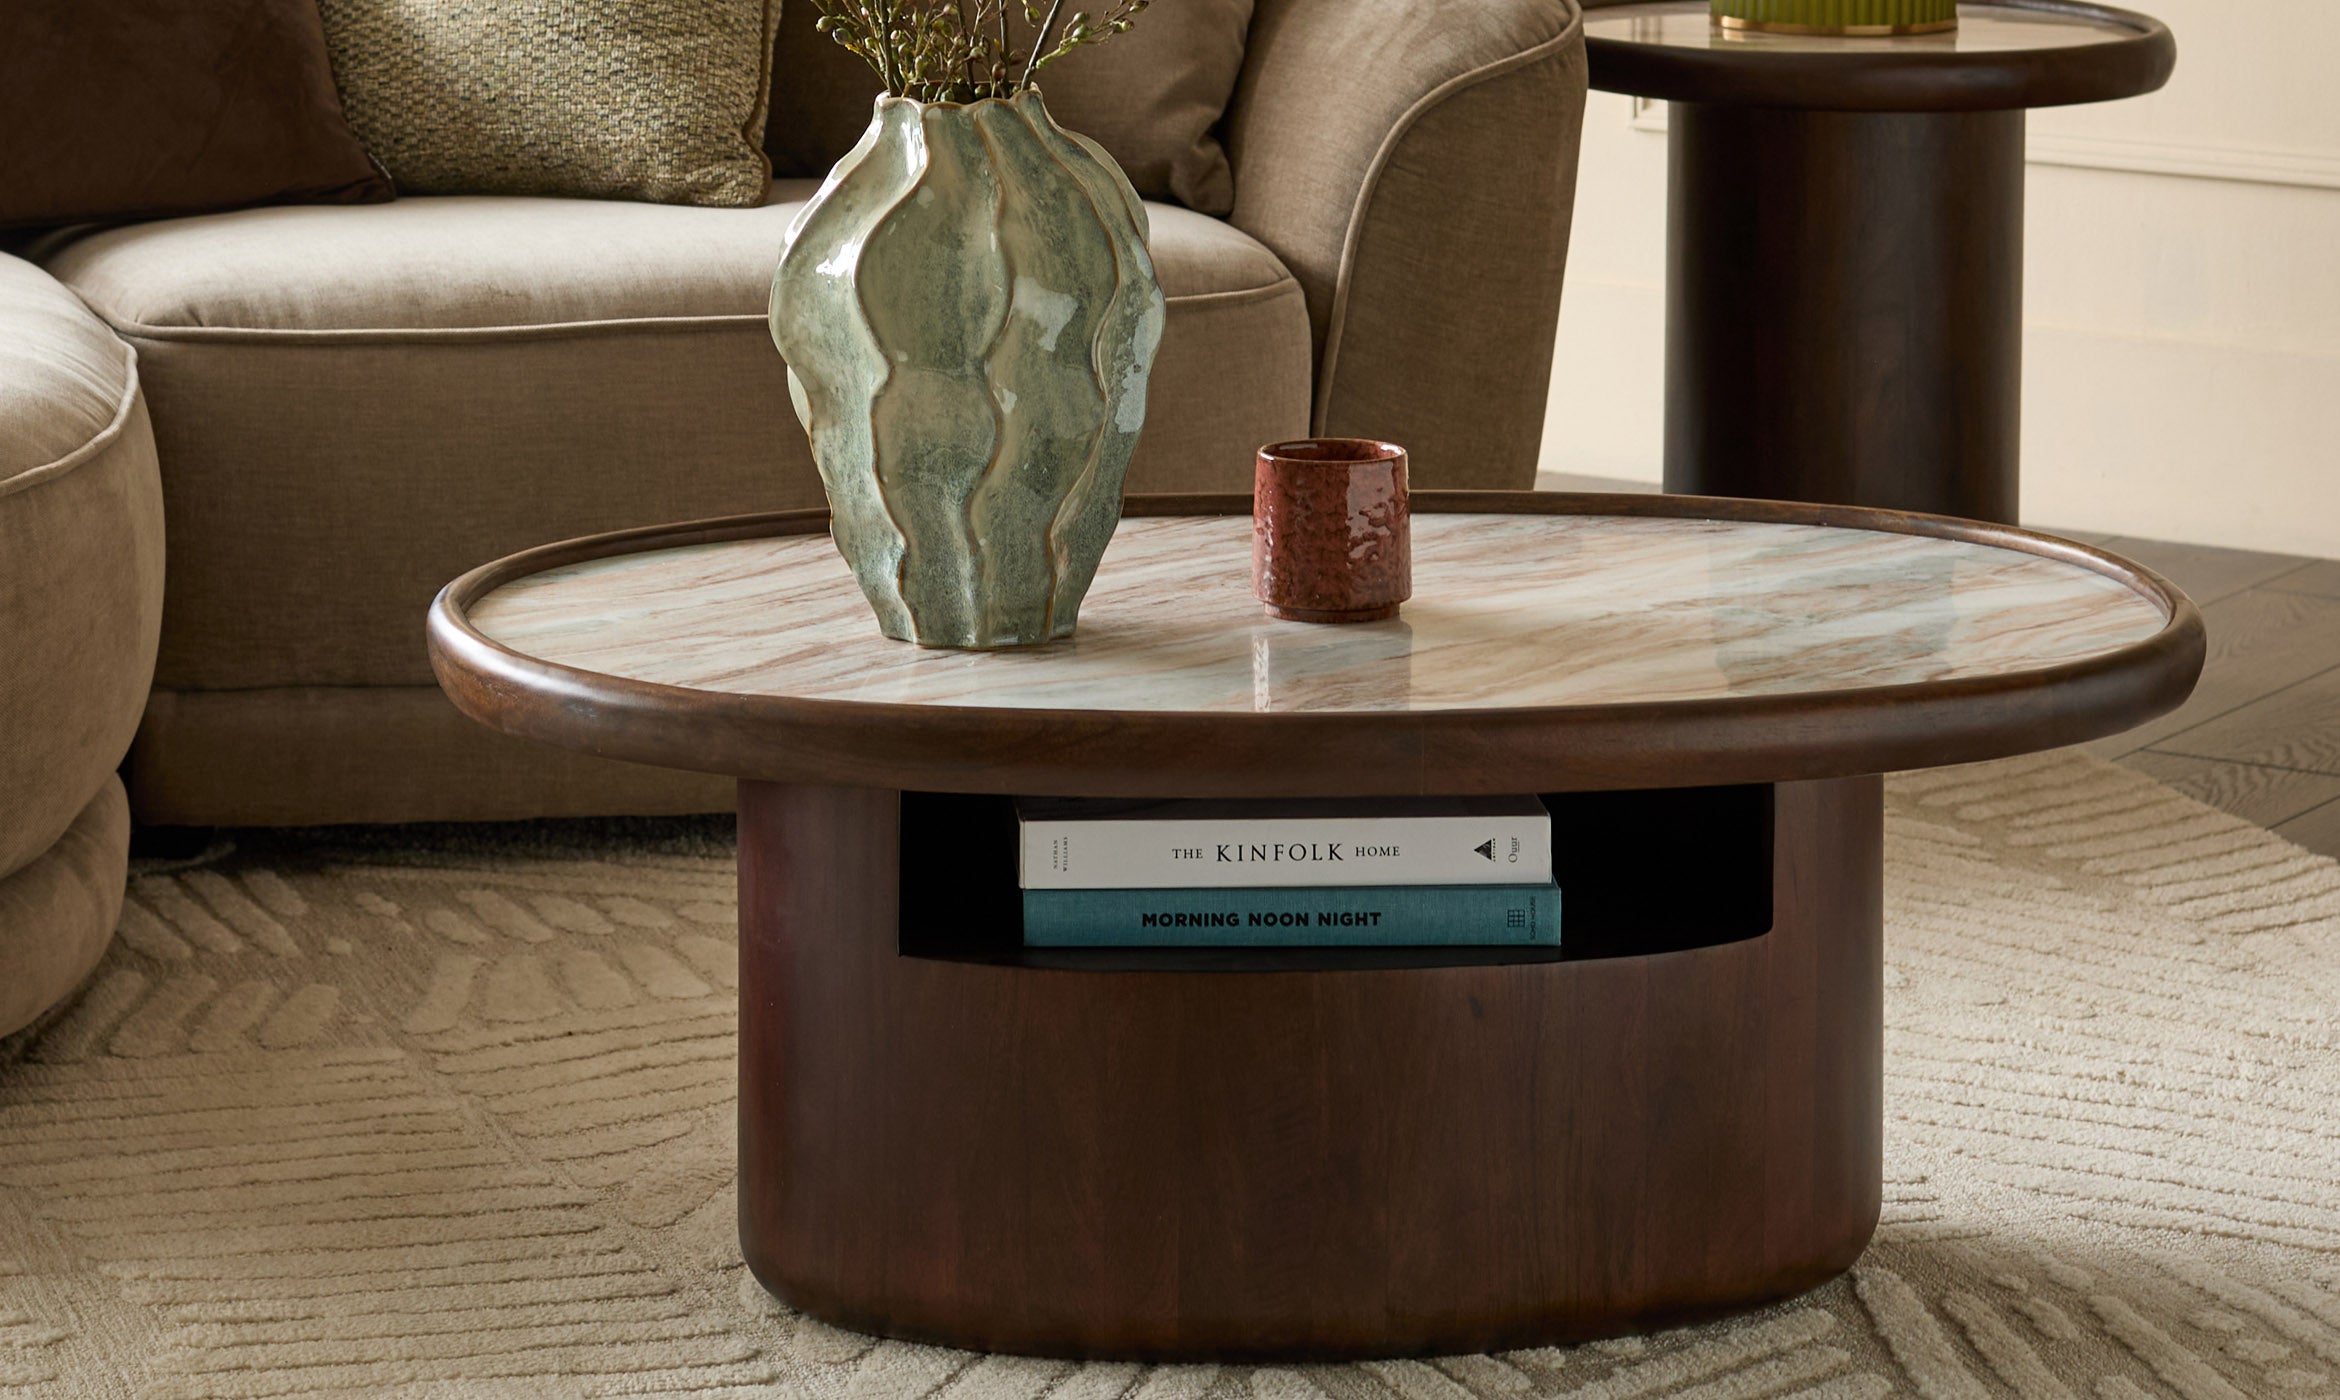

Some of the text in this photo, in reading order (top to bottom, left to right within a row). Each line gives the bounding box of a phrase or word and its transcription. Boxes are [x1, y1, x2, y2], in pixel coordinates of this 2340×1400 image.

[1171, 843, 1401, 863] THE KINFOLK HOME
[1141, 911, 1382, 928] MORNING NOON NIGHT
